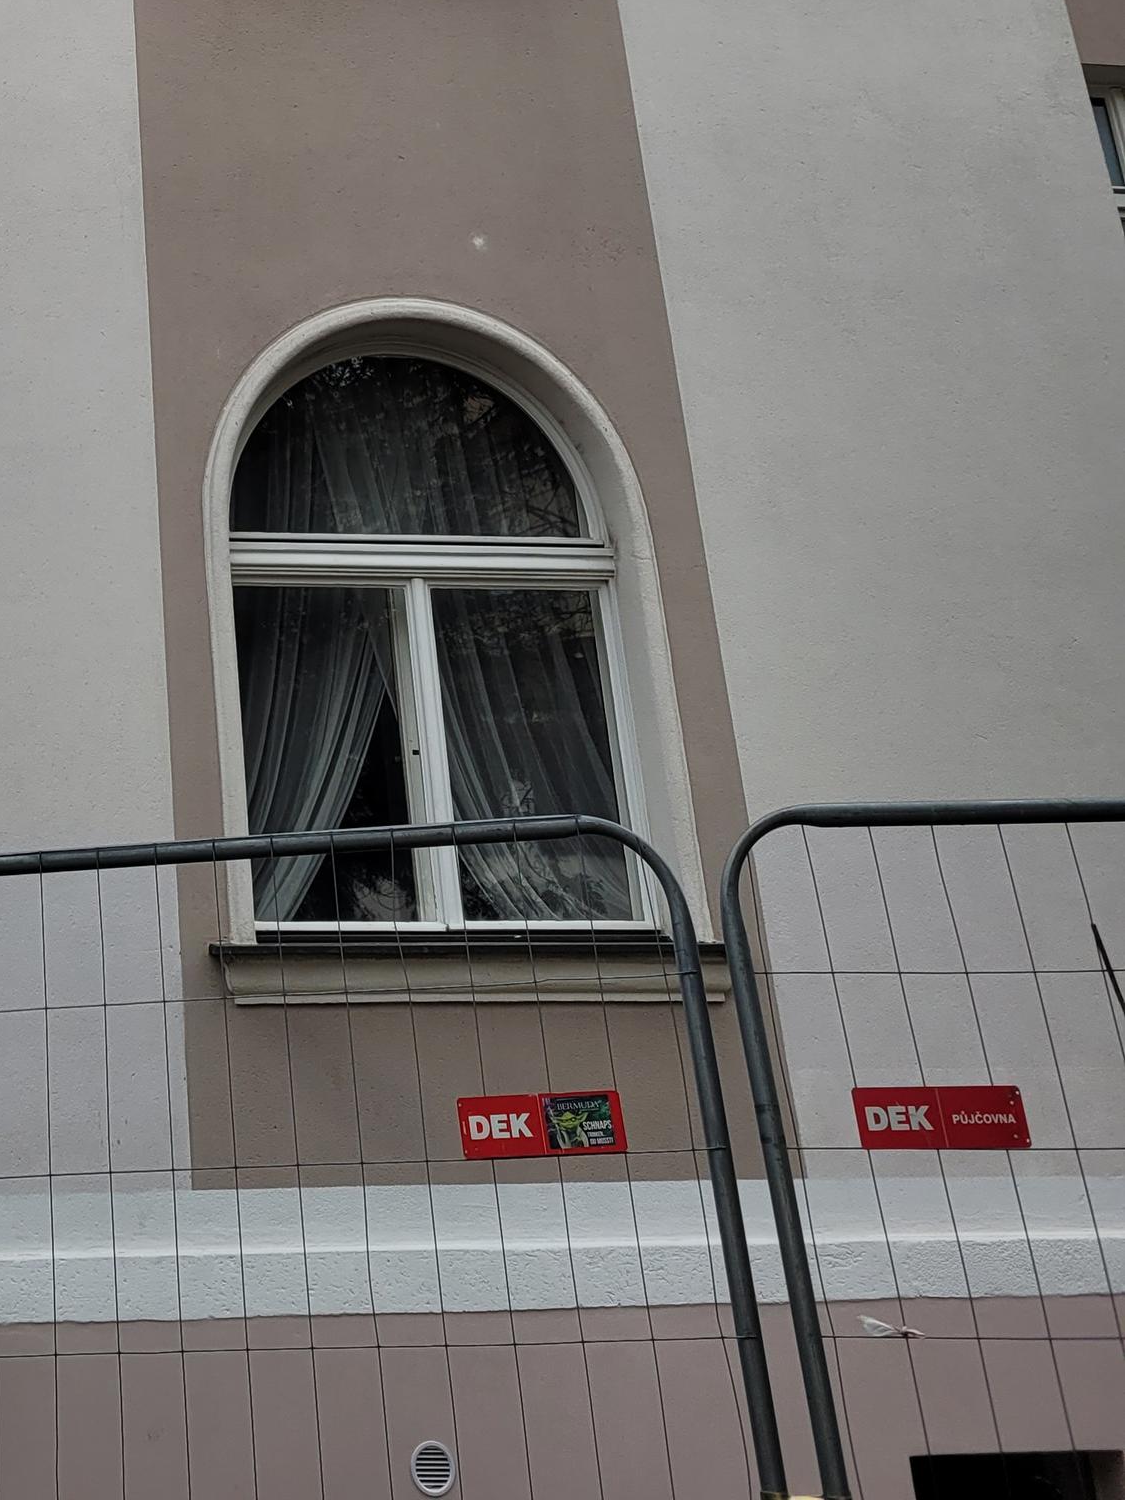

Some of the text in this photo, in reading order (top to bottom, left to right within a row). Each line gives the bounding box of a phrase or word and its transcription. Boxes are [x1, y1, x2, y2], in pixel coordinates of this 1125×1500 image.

[468, 1113, 534, 1140] DEK
[582, 1119, 612, 1131] SCHNAPS
[864, 1105, 1017, 1131] DEK PŮJČOVNA
